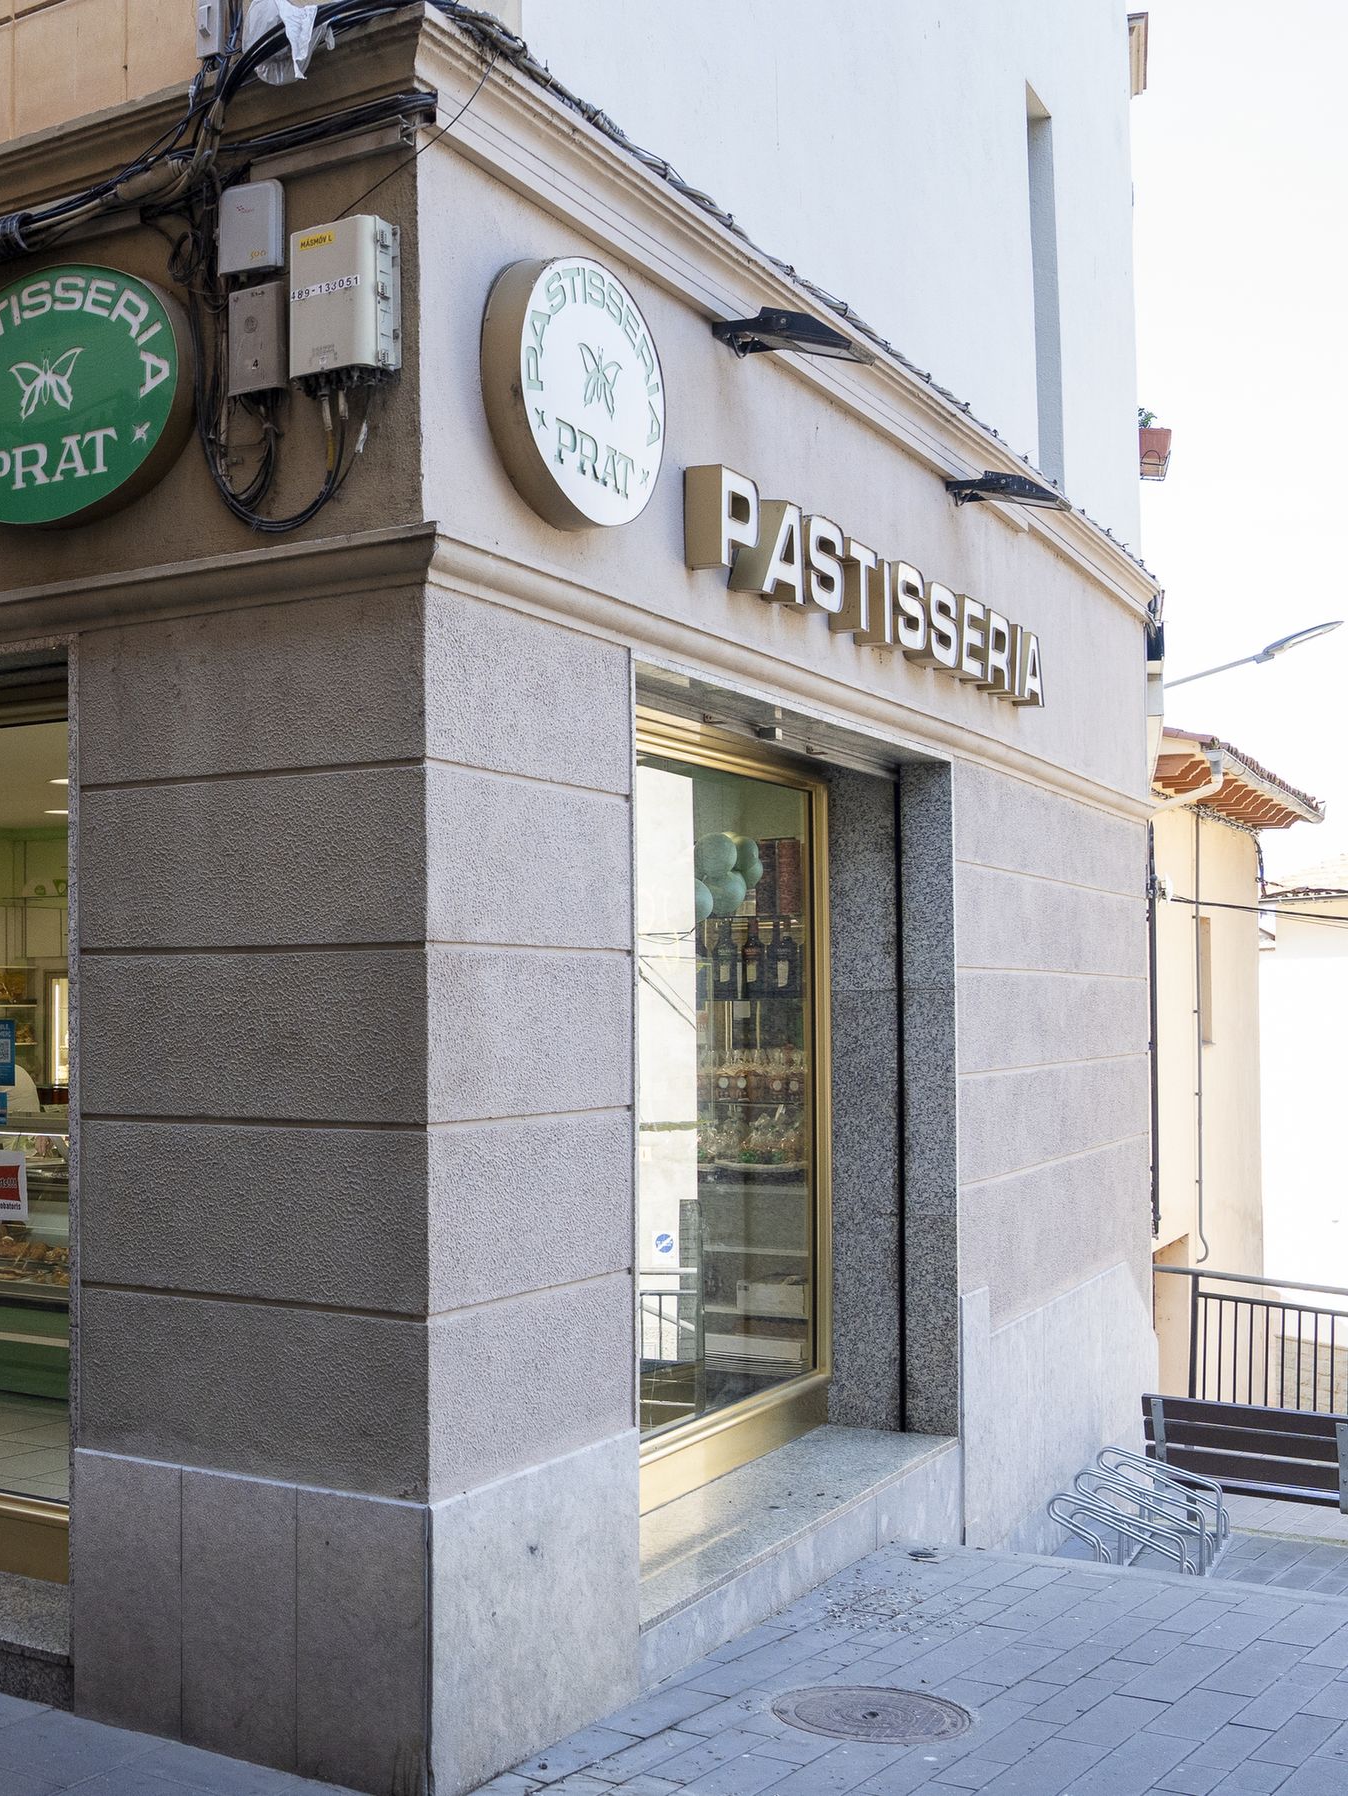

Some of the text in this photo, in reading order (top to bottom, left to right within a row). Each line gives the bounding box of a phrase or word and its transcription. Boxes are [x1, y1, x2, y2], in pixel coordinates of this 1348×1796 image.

[300, 234, 333, 249] MÁSMÓVL
[525, 267, 661, 447] PASTISSERIA
[553, 417, 635, 501] PRAT
[702, 465, 1044, 708] PASTISSERIA
